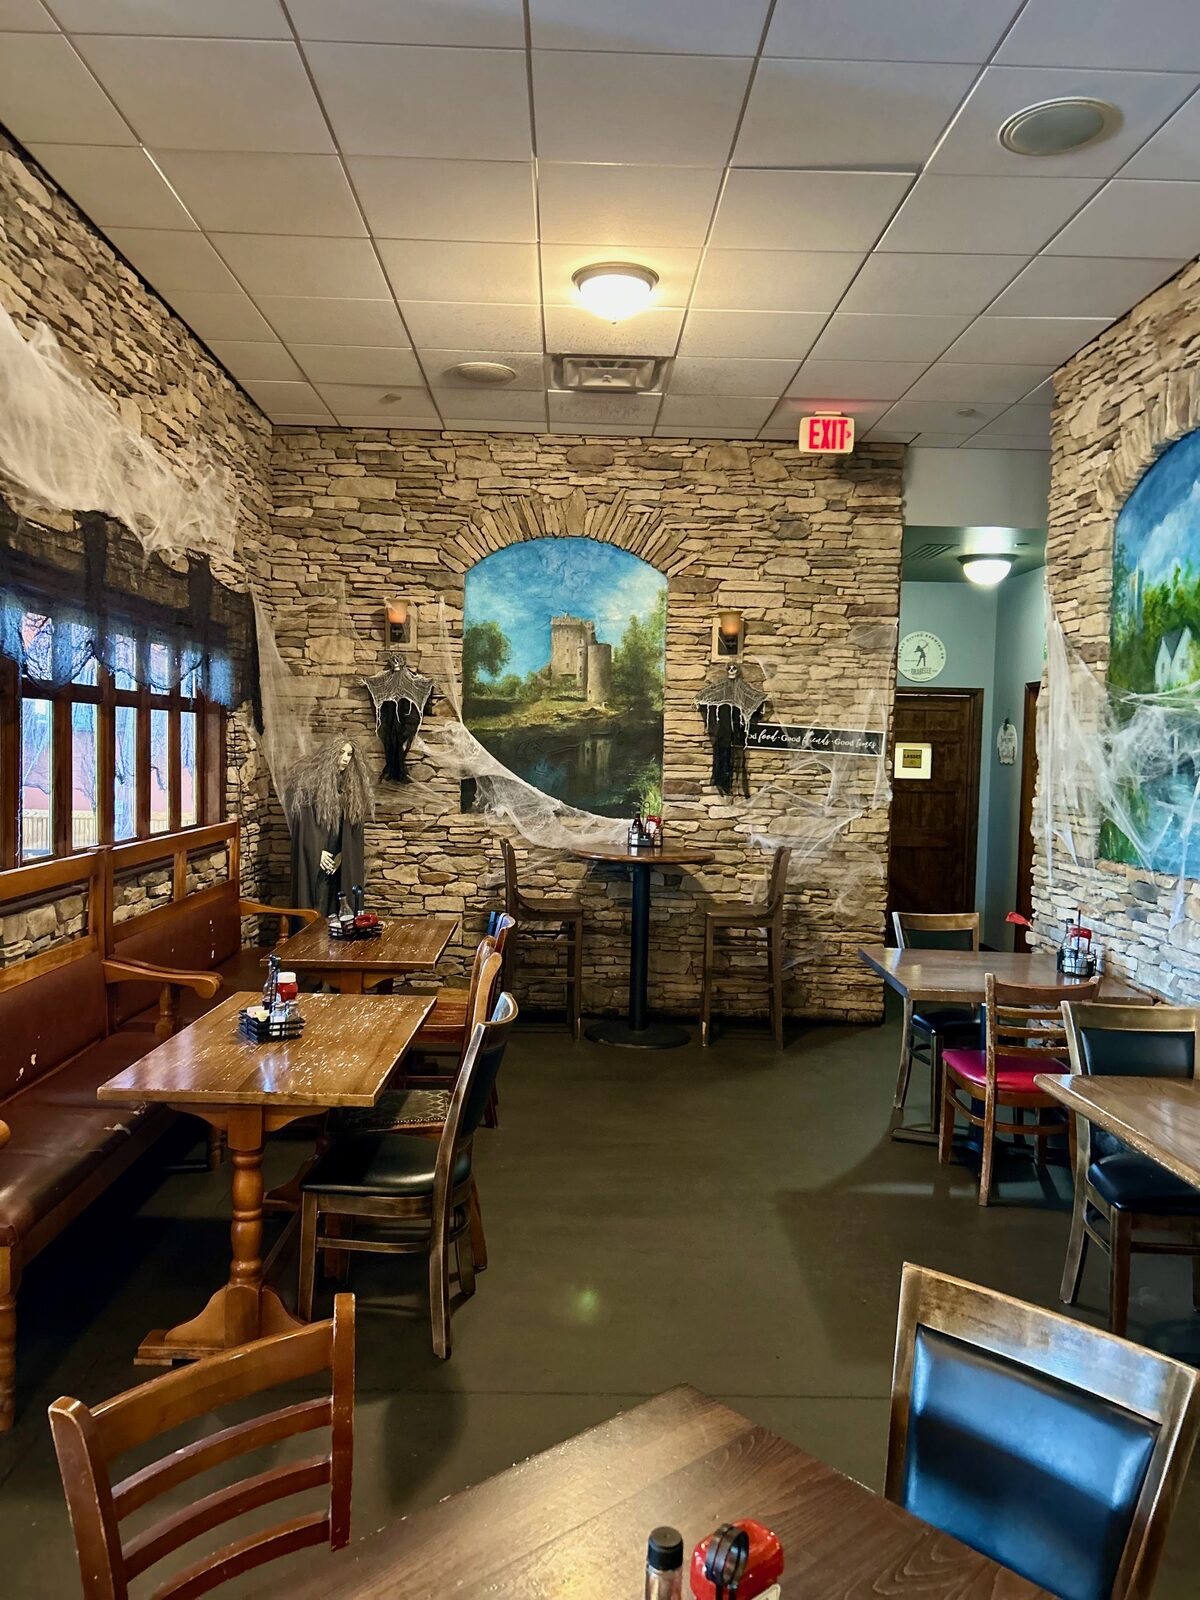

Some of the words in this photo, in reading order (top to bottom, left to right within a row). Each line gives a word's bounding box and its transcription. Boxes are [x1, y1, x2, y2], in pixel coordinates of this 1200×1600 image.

[809, 419, 848, 449] EXIT
[757, 729, 779, 743] food
[834, 738, 854, 747] Good
